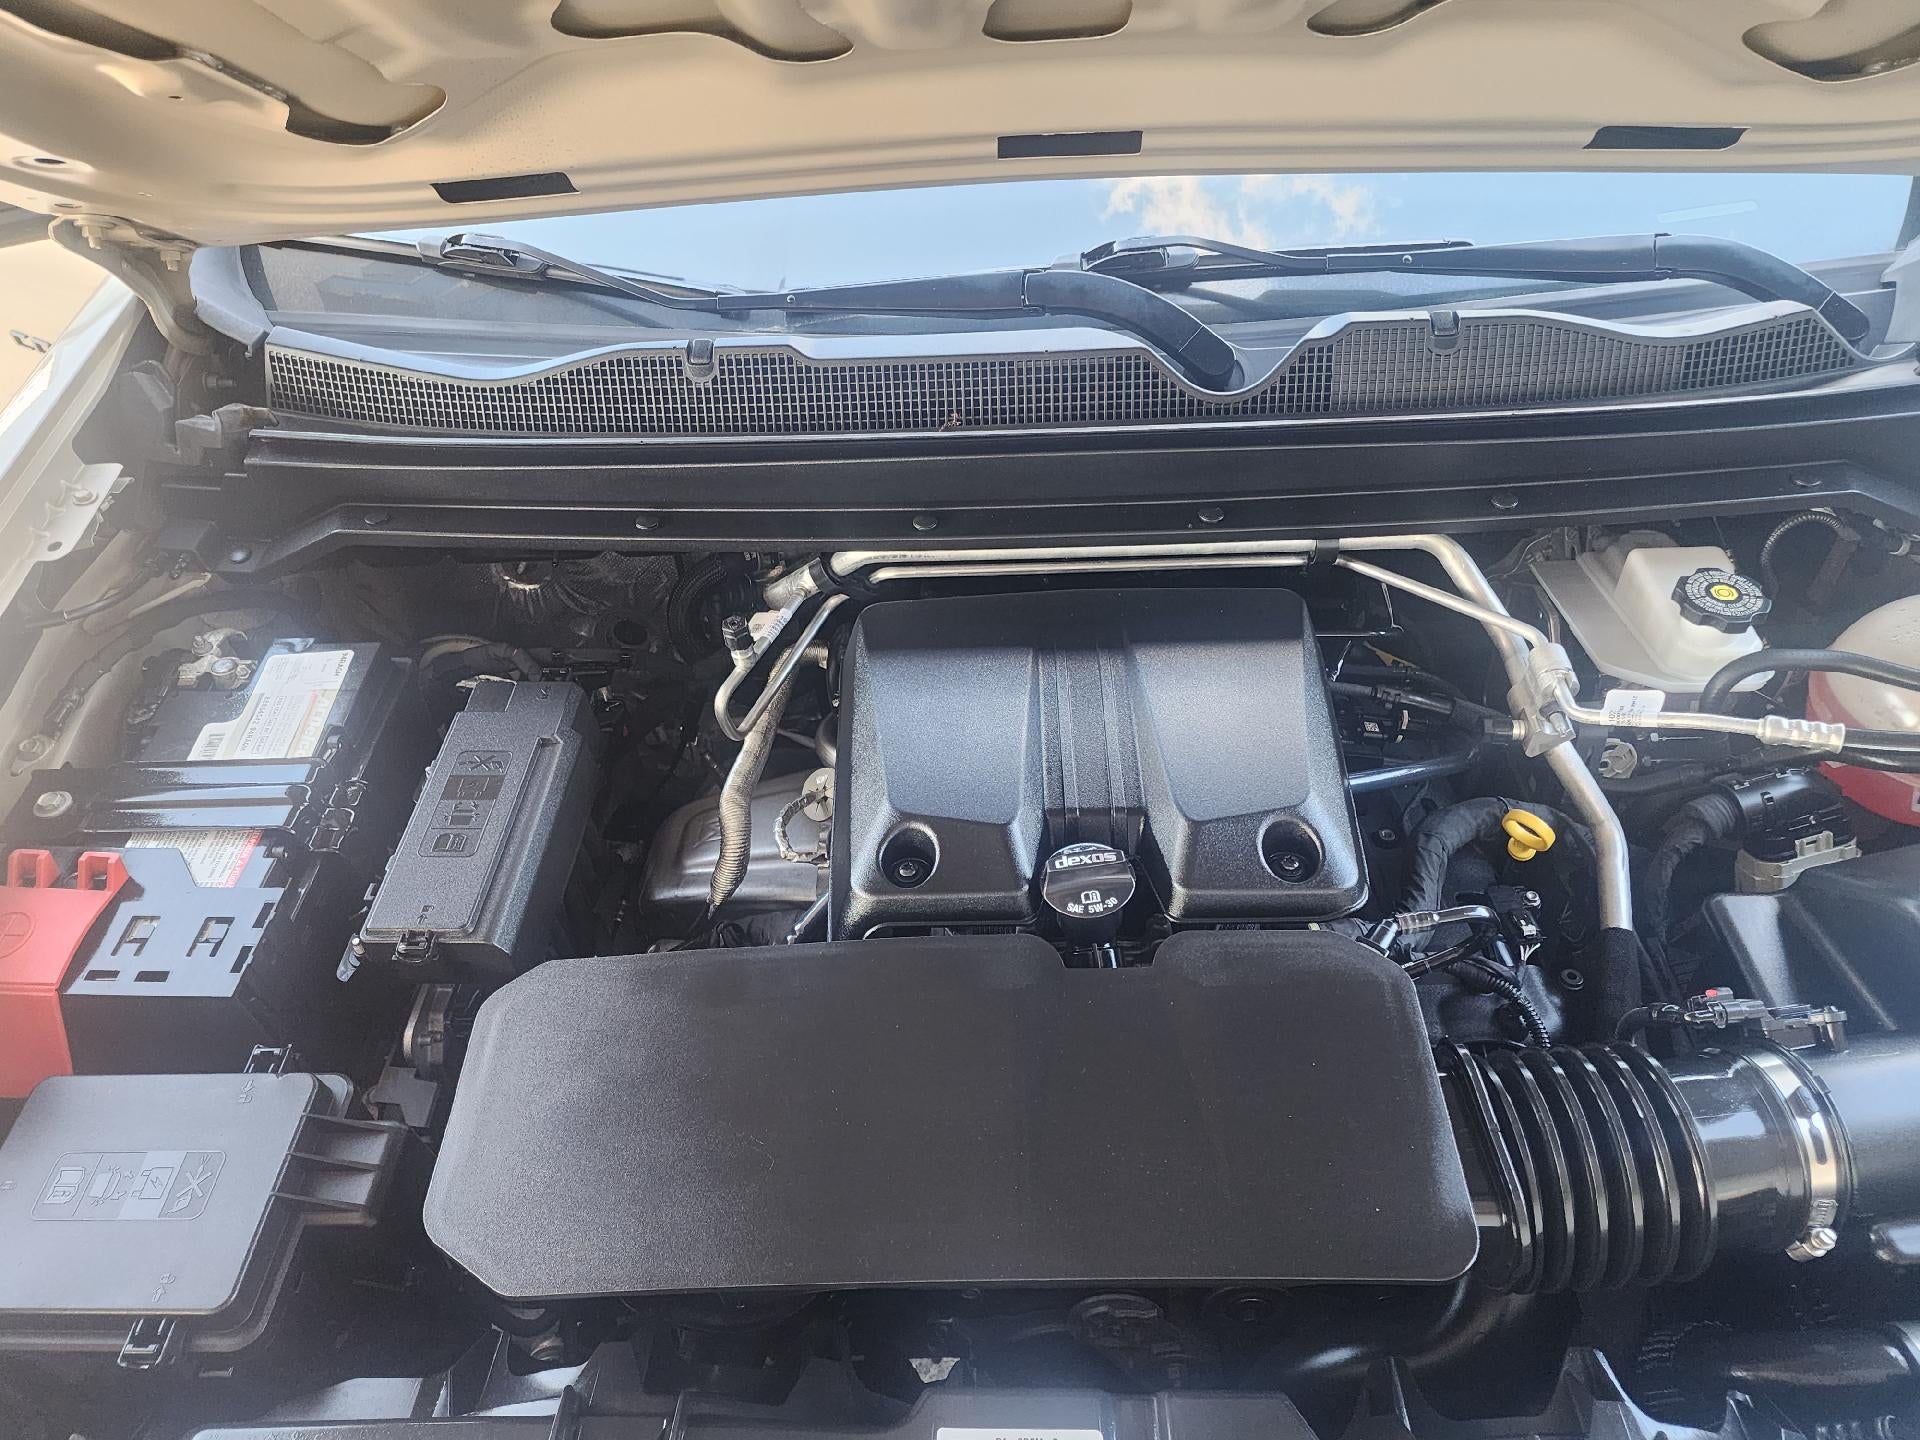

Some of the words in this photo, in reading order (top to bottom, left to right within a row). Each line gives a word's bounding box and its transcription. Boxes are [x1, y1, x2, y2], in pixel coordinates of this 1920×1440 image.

[1055, 852, 1117, 869] dexos
[1066, 902, 1084, 913] SAE
[1088, 897, 1118, 914] 5W-30
